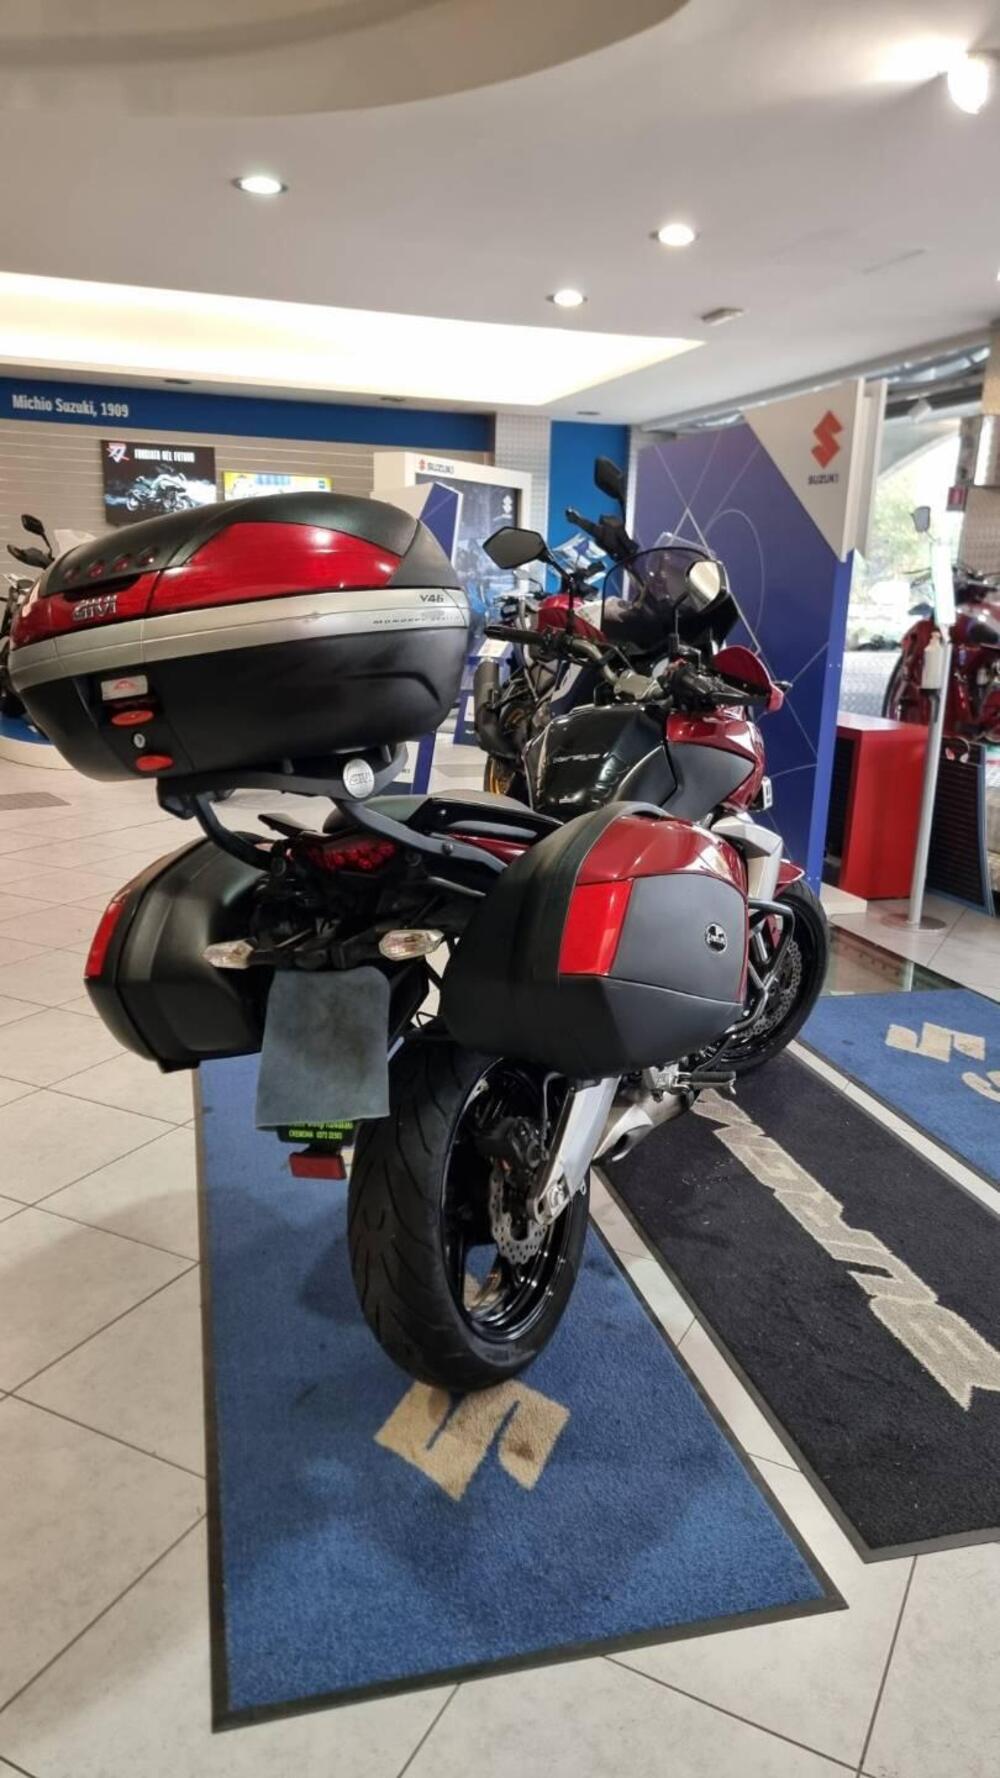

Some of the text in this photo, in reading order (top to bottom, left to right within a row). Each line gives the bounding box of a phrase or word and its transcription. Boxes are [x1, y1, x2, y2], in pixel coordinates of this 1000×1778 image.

[12, 394, 129, 418] Michio Suzuki, 1909
[808, 473, 839, 485] SUZUKI
[72, 594, 118, 620] GIVI
[693, 1087, 1000, 1411] BURGM
